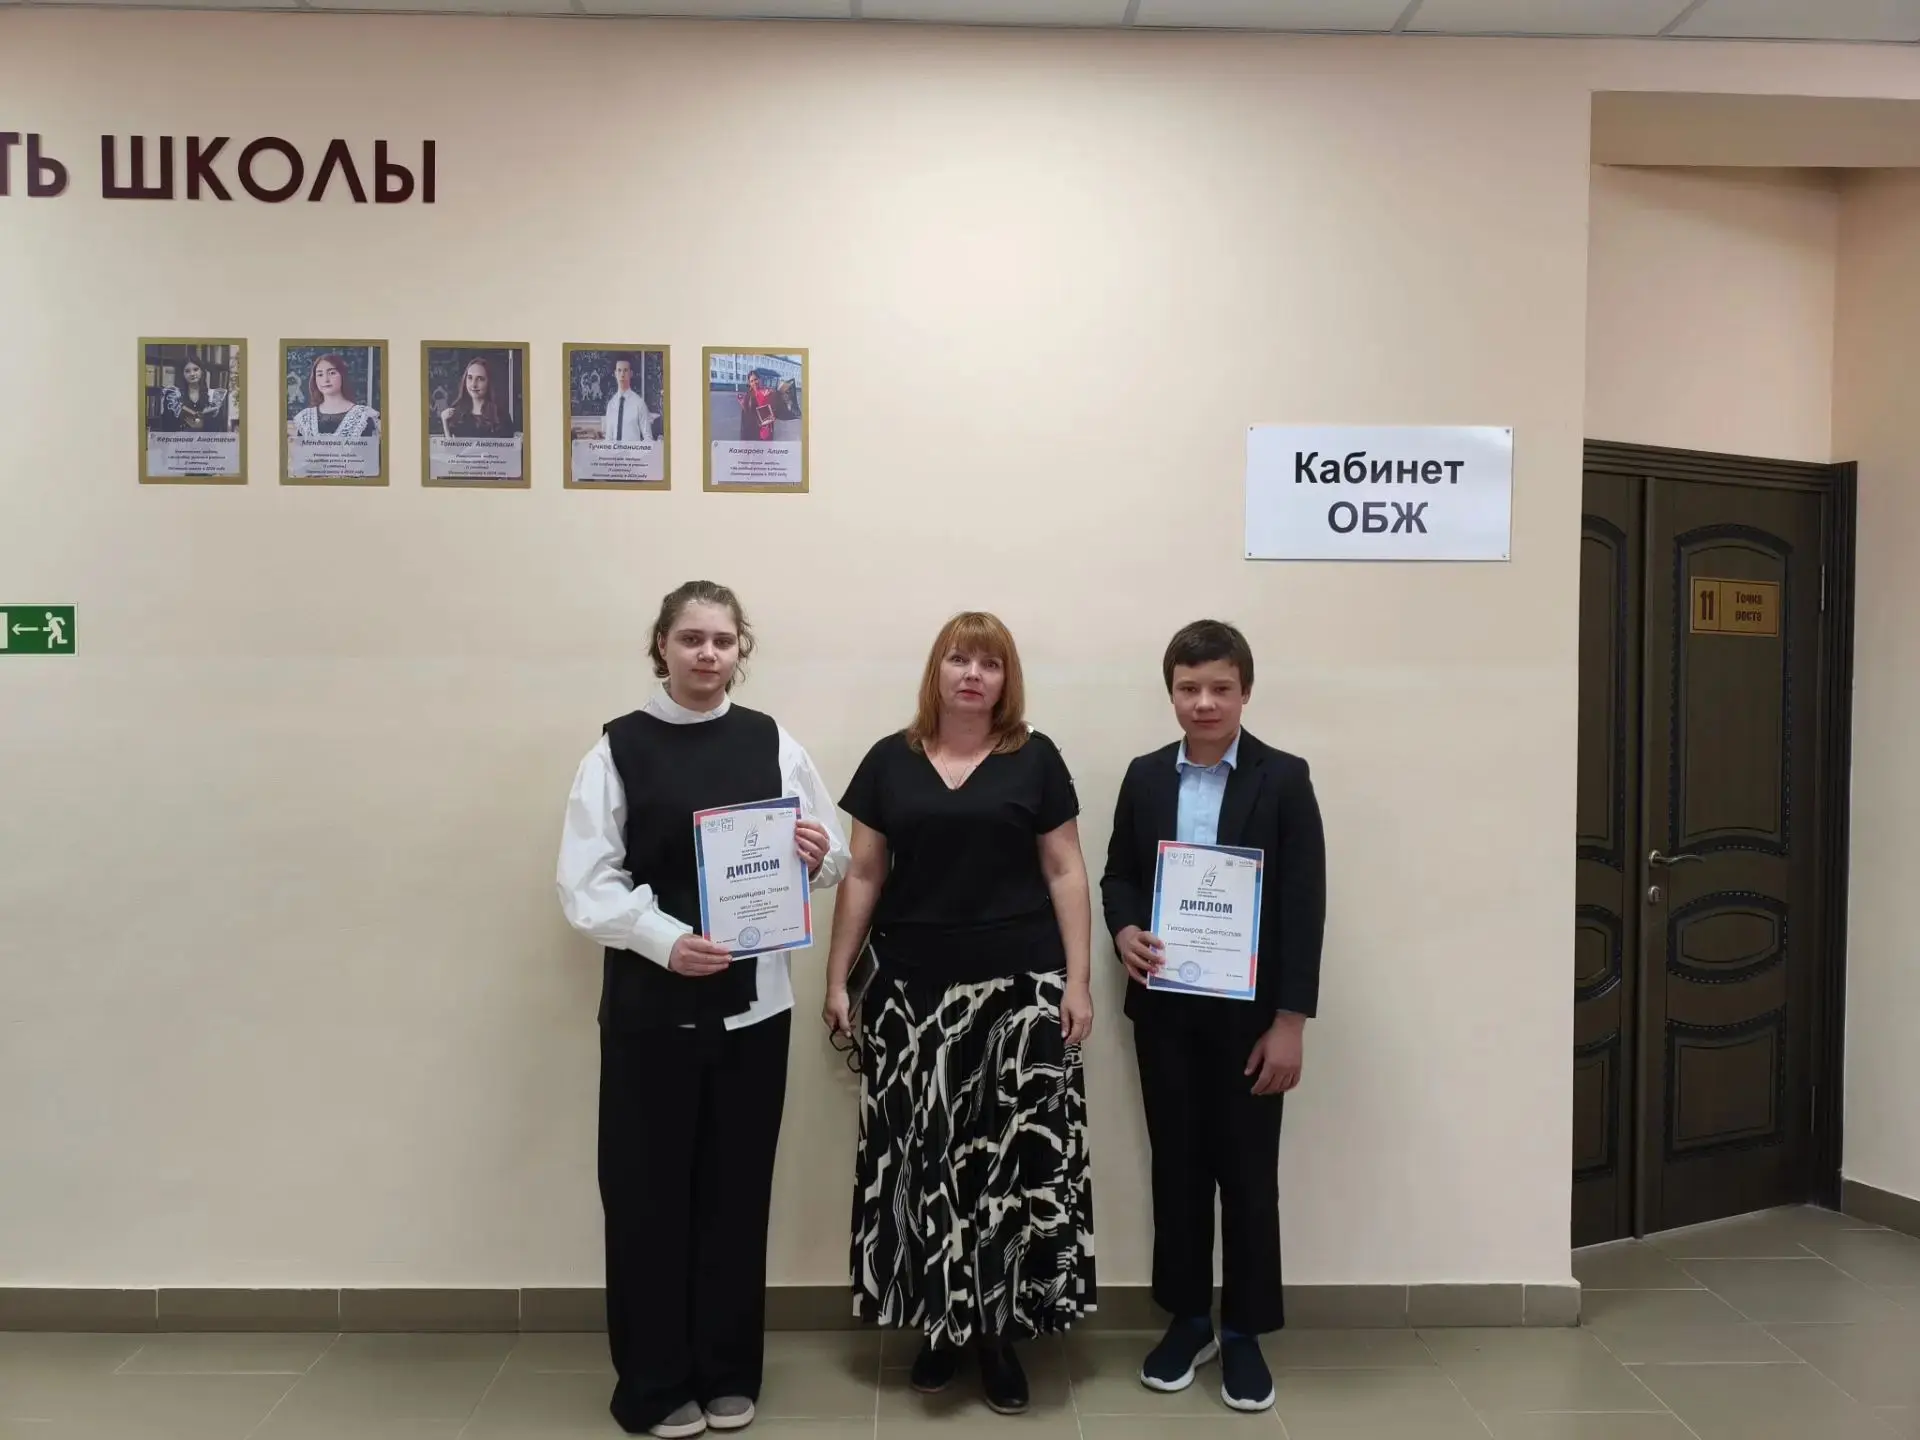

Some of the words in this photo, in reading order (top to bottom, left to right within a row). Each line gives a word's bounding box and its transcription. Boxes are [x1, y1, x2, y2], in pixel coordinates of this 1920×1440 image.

[102, 134, 436, 203] ШКОЛЫ
[1294, 451, 1465, 484] Кабинет
[1327, 500, 1429, 534] ОБЖ
[1700, 590, 1714, 620] 11
[1735, 591, 1763, 605] Точка
[1735, 610, 1762, 622] роста
[726, 859, 780, 879] ДИПЛОМ
[1179, 899, 1233, 914] ДИПЛОМ
